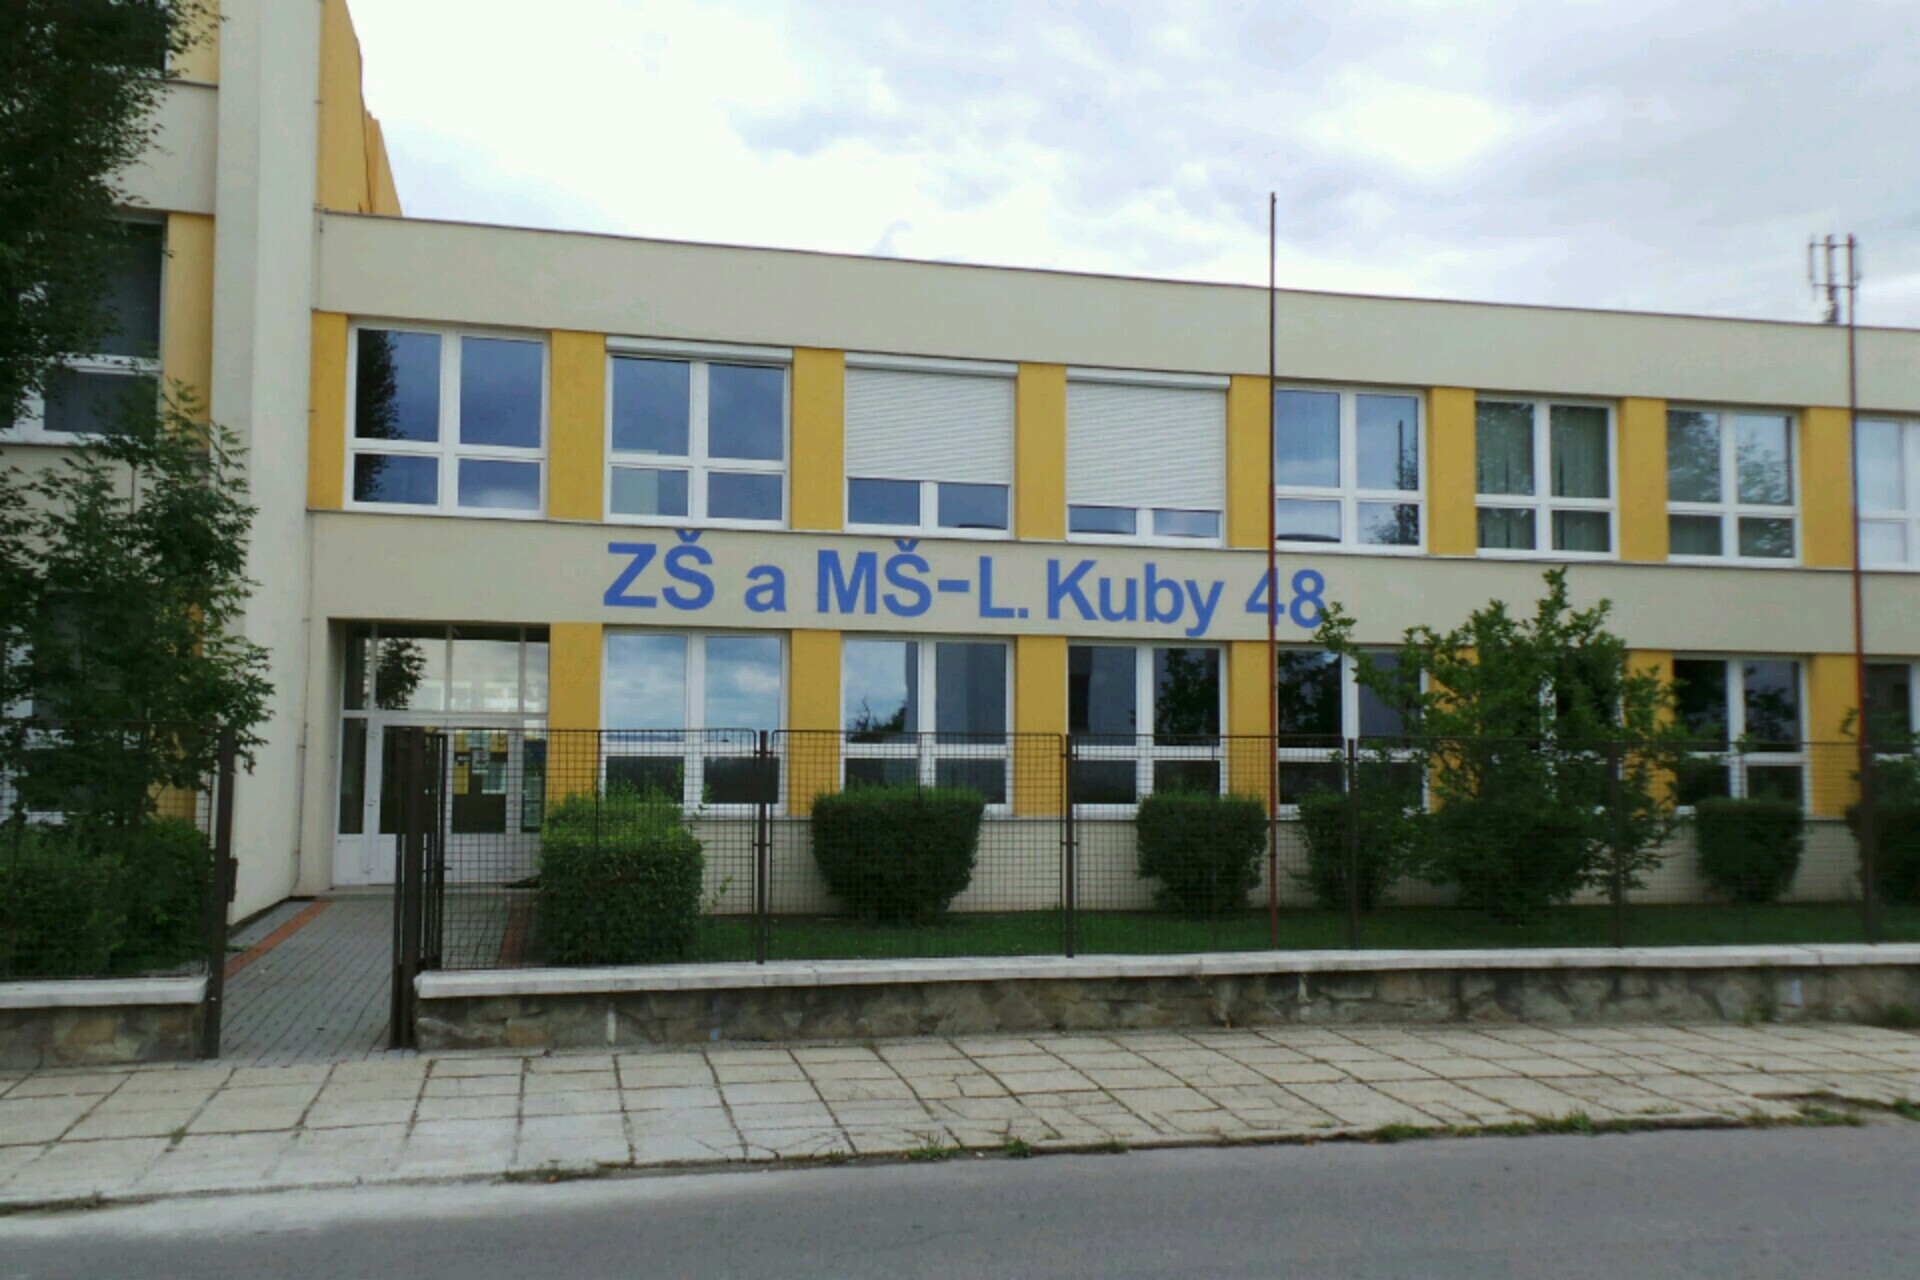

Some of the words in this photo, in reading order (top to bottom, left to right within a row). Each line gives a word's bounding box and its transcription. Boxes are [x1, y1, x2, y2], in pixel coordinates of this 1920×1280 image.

[603, 529, 715, 611] ZŠ
[744, 565, 787, 613] a
[1047, 559, 1225, 638] Kuby
[1245, 569, 1326, 630] 48
